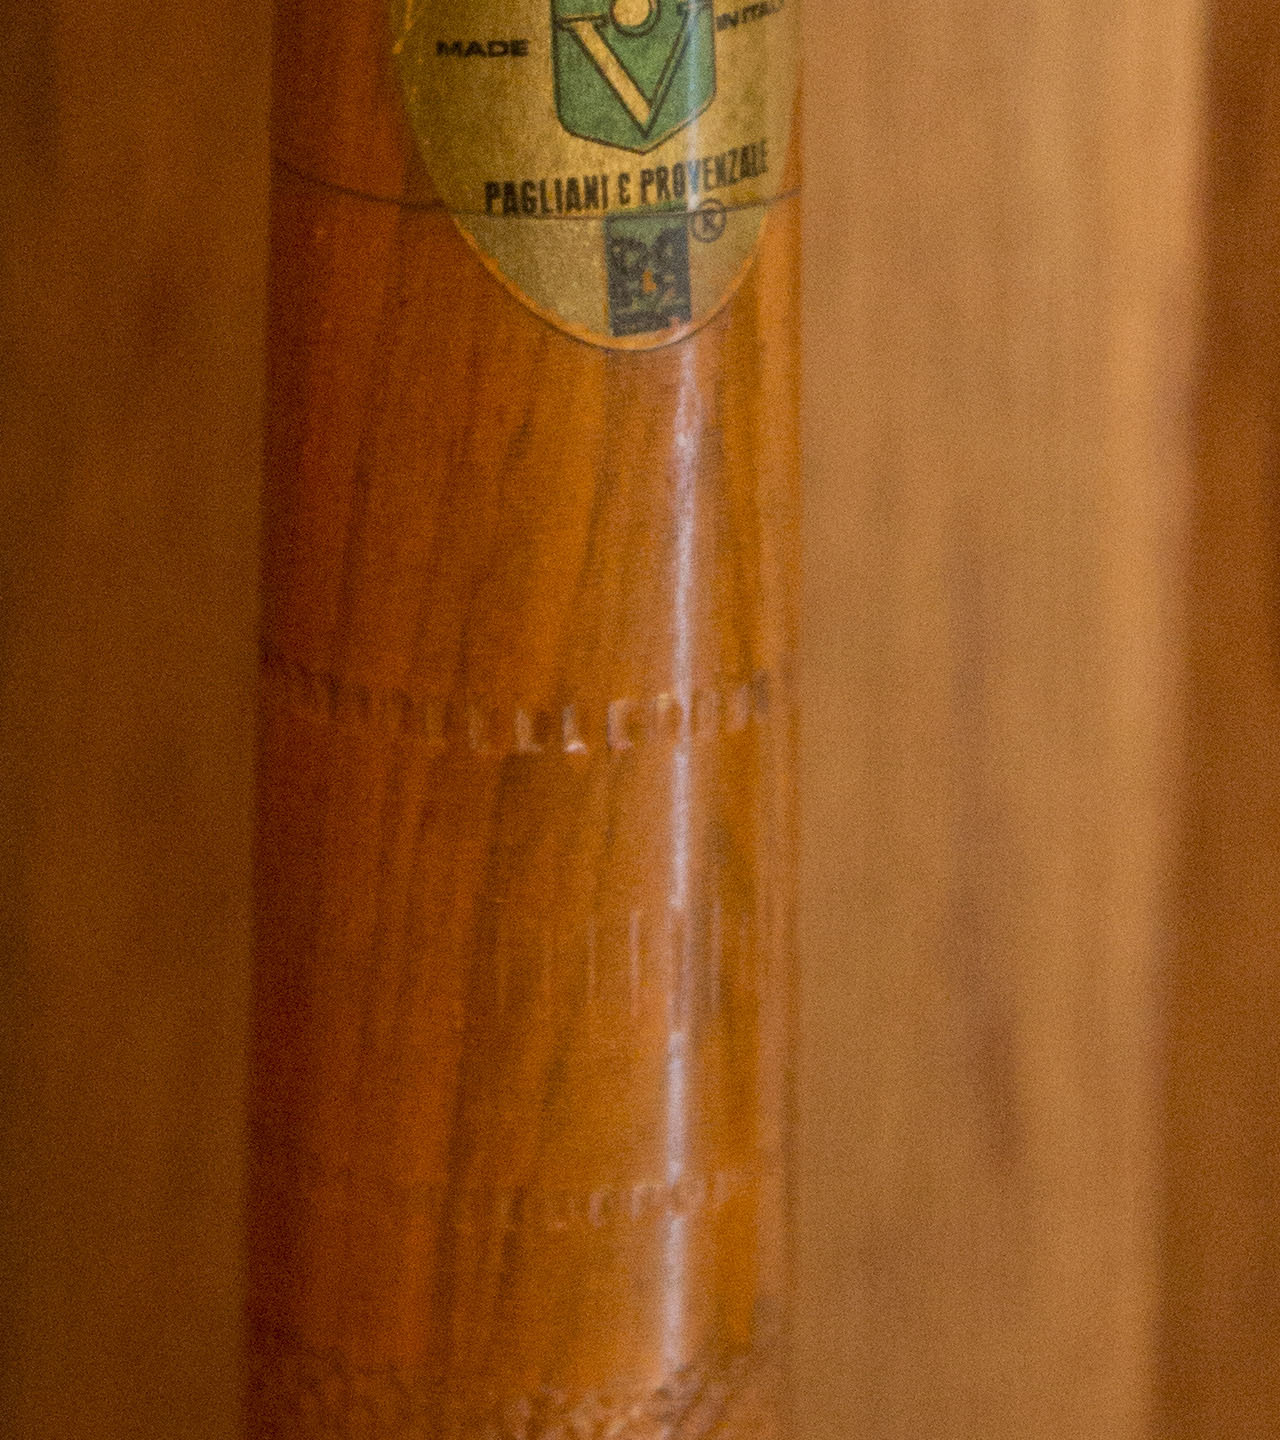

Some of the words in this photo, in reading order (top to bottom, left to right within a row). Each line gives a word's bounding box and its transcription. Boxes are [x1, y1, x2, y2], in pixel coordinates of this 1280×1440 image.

[435, 38, 529, 58] MADE
[715, 9, 739, 32] IN
[483, 173, 610, 215] PAGLIANI
[639, 136, 770, 205] PROVENZALE
